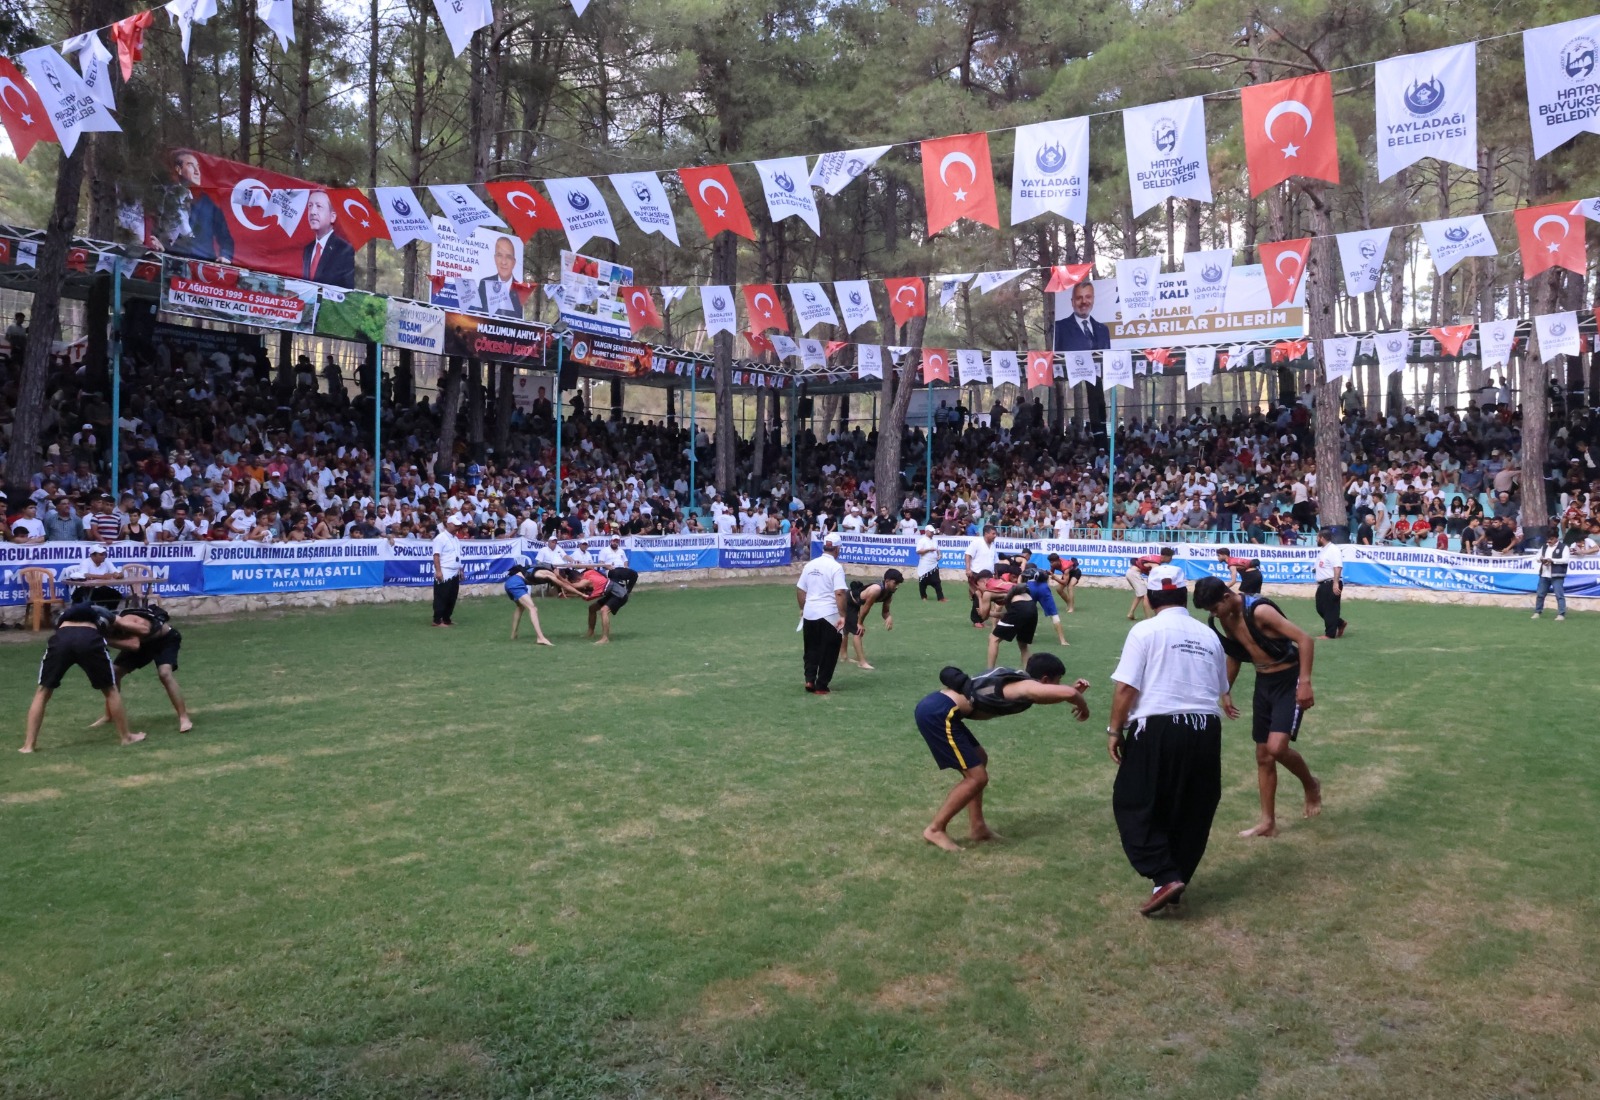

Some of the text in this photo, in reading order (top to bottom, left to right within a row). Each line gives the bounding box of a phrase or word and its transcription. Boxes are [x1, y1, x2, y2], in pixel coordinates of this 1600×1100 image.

[1557, 84, 1600, 100] HATAY
[1539, 94, 1600, 115] BÜYÜKŞE
[1546, 105, 1600, 126] BELEDİY
[1387, 113, 1465, 134] YAYLADAĞI
[1388, 127, 1466, 147] BELEDİYESİ
[1151, 156, 1183, 169] HATAY
[1137, 161, 1200, 181] BÜYÜKŞEHİR
[1021, 176, 1080, 187] YAYLADAĞI
[1143, 173, 1196, 190] BELEDİYESİ
[1020, 188, 1081, 197] BELEDİYESİ
[770, 200, 813, 211] BELEDİYESİ
[566, 210, 605, 223] YAYLADAĞI
[438, 224, 451, 232] ABA
[570, 218, 608, 231] BELEDİYESİ
[437, 251, 479, 265] SPORCULARA
[466, 248, 478, 256] TÜM
[437, 260, 472, 272] BAŞARILAR
[437, 269, 461, 278] DİLERİM
[178, 281, 186, 289] 17
[189, 283, 223, 296] AĞUSTOS
[226, 290, 243, 300] 1999
[255, 295, 278, 305] ŞUBAT
[280, 300, 298, 308] 2023
[174, 291, 298, 320] İKİ TARİH TEK ACI UNUTMADIK
[399, 320, 422, 333] YAŞAMI
[1115, 311, 1286, 336] BAŞARILAR DİLERİM
[477, 323, 541, 341] MAZLUMUN AHIYLA
[398, 333, 435, 348] KORUMAKTIR
[594, 341, 612, 349] YANGIN
[0, 545, 196, 561] RCULARIMIZA BARILAR DİLERİM.
[211, 544, 379, 560] SPORCULARIMIZA BAŞARILAR DİLERİM.
[394, 546, 433, 556] SPORCULAR
[462, 546, 488, 557] ŞARILAR
[865, 547, 909, 556] ERDOĞAN
[1047, 544, 1106, 553] SPORCULARIMIZA
[1108, 545, 1147, 554] BAŞARILAR
[1261, 549, 1306, 560] BAŞARILAR
[654, 553, 674, 562] HALİL
[1356, 550, 1534, 570] SPORCULARIMIZA BAŞARILAR DİLERİM.
[1569, 561, 1600, 570] ORCUL
[232, 566, 361, 580] MUSTAFA MASATLI
[1391, 566, 1494, 584] LÜTFİ KAŞIKÇI
[160, 584, 190, 592] BAKANI
[301, 578, 325, 586] VALİSİ
